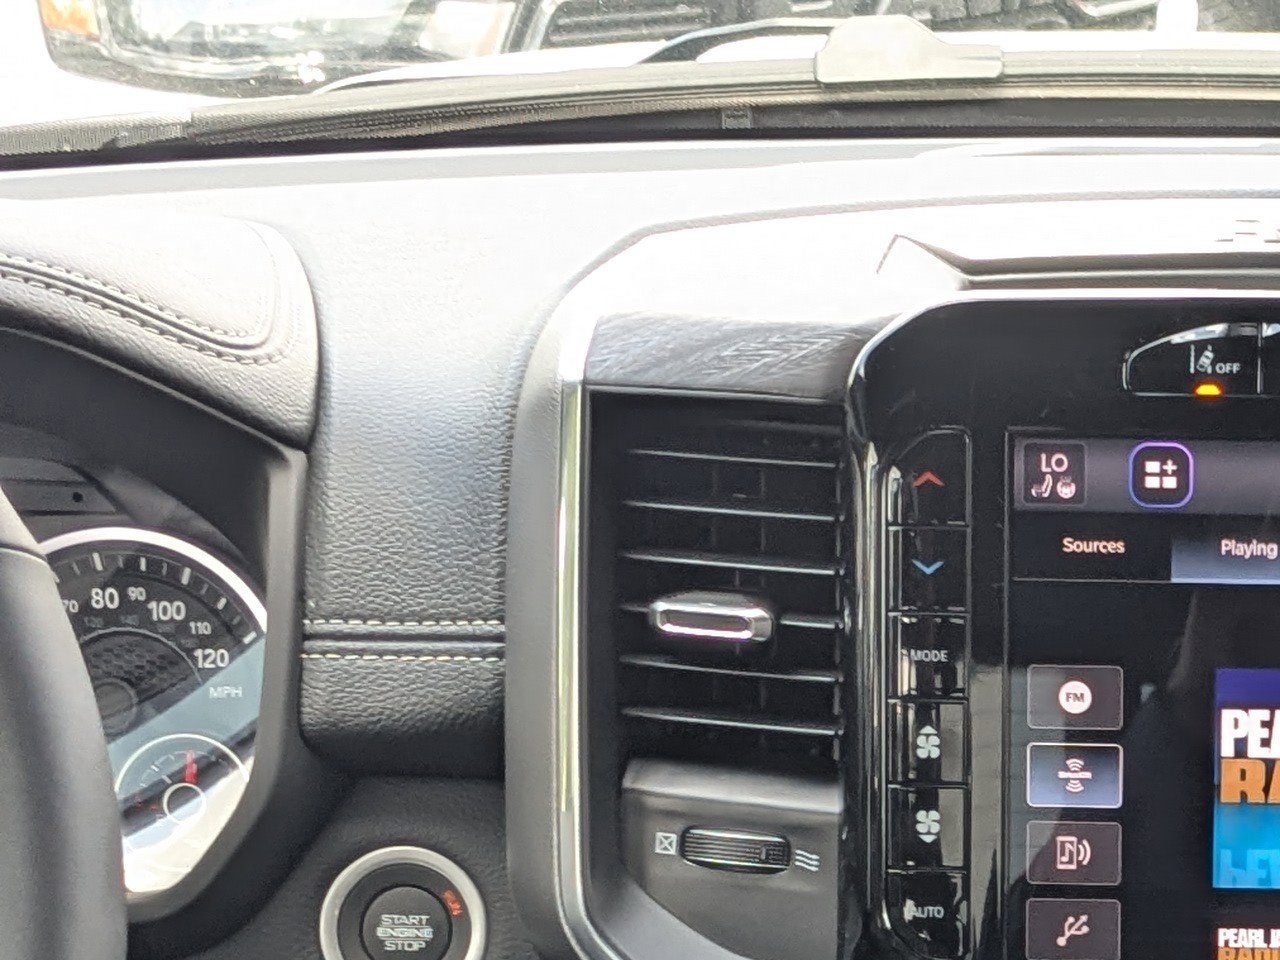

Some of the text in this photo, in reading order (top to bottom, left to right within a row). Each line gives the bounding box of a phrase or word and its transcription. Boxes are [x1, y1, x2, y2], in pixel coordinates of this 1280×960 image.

[1215, 362, 1241, 374] OFF
[1041, 453, 1068, 473] LO
[1062, 537, 1125, 554] Sources
[1221, 539, 1278, 560] Playing
[91, 587, 119, 609] 80
[127, 586, 147, 601] 90
[147, 601, 186, 621] 100
[189, 621, 212, 635] 110
[193, 648, 229, 668] 120
[911, 649, 949, 662] MODE
[209, 687, 242, 698] MPH
[1065, 692, 1084, 702] FM
[908, 906, 944, 918] AUTO
[381, 914, 430, 925] START
[376, 927, 433, 938] ENGINE
[1218, 928, 1268, 948] PEARL
[384, 940, 426, 951] STOP
